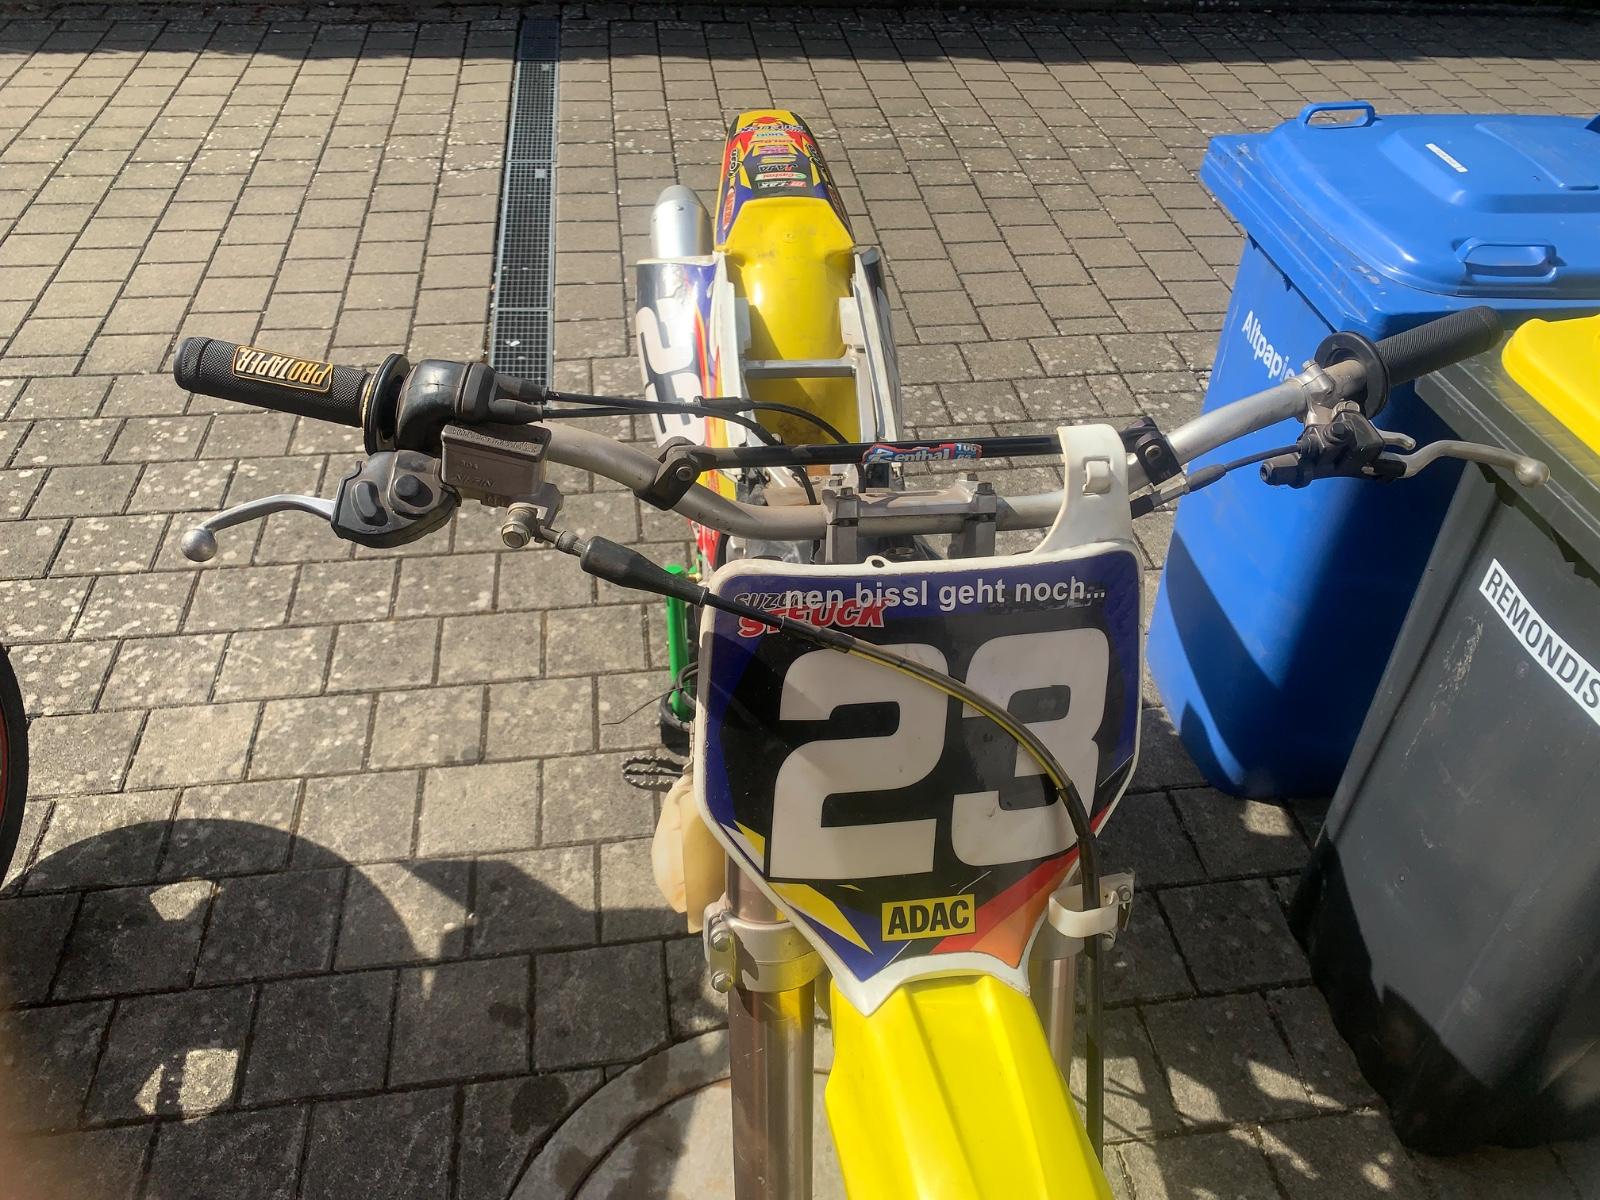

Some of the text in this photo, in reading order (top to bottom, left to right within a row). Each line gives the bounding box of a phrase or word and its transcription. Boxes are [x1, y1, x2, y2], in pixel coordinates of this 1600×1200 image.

[235, 347, 333, 385] PROTAPER
[785, 588, 844, 609] nen
[856, 580, 928, 608] bissl
[938, 578, 1006, 611] geht
[1485, 567, 1600, 708] REMONDIS
[770, 627, 1110, 880] 23
[887, 900, 970, 935] ADAC
